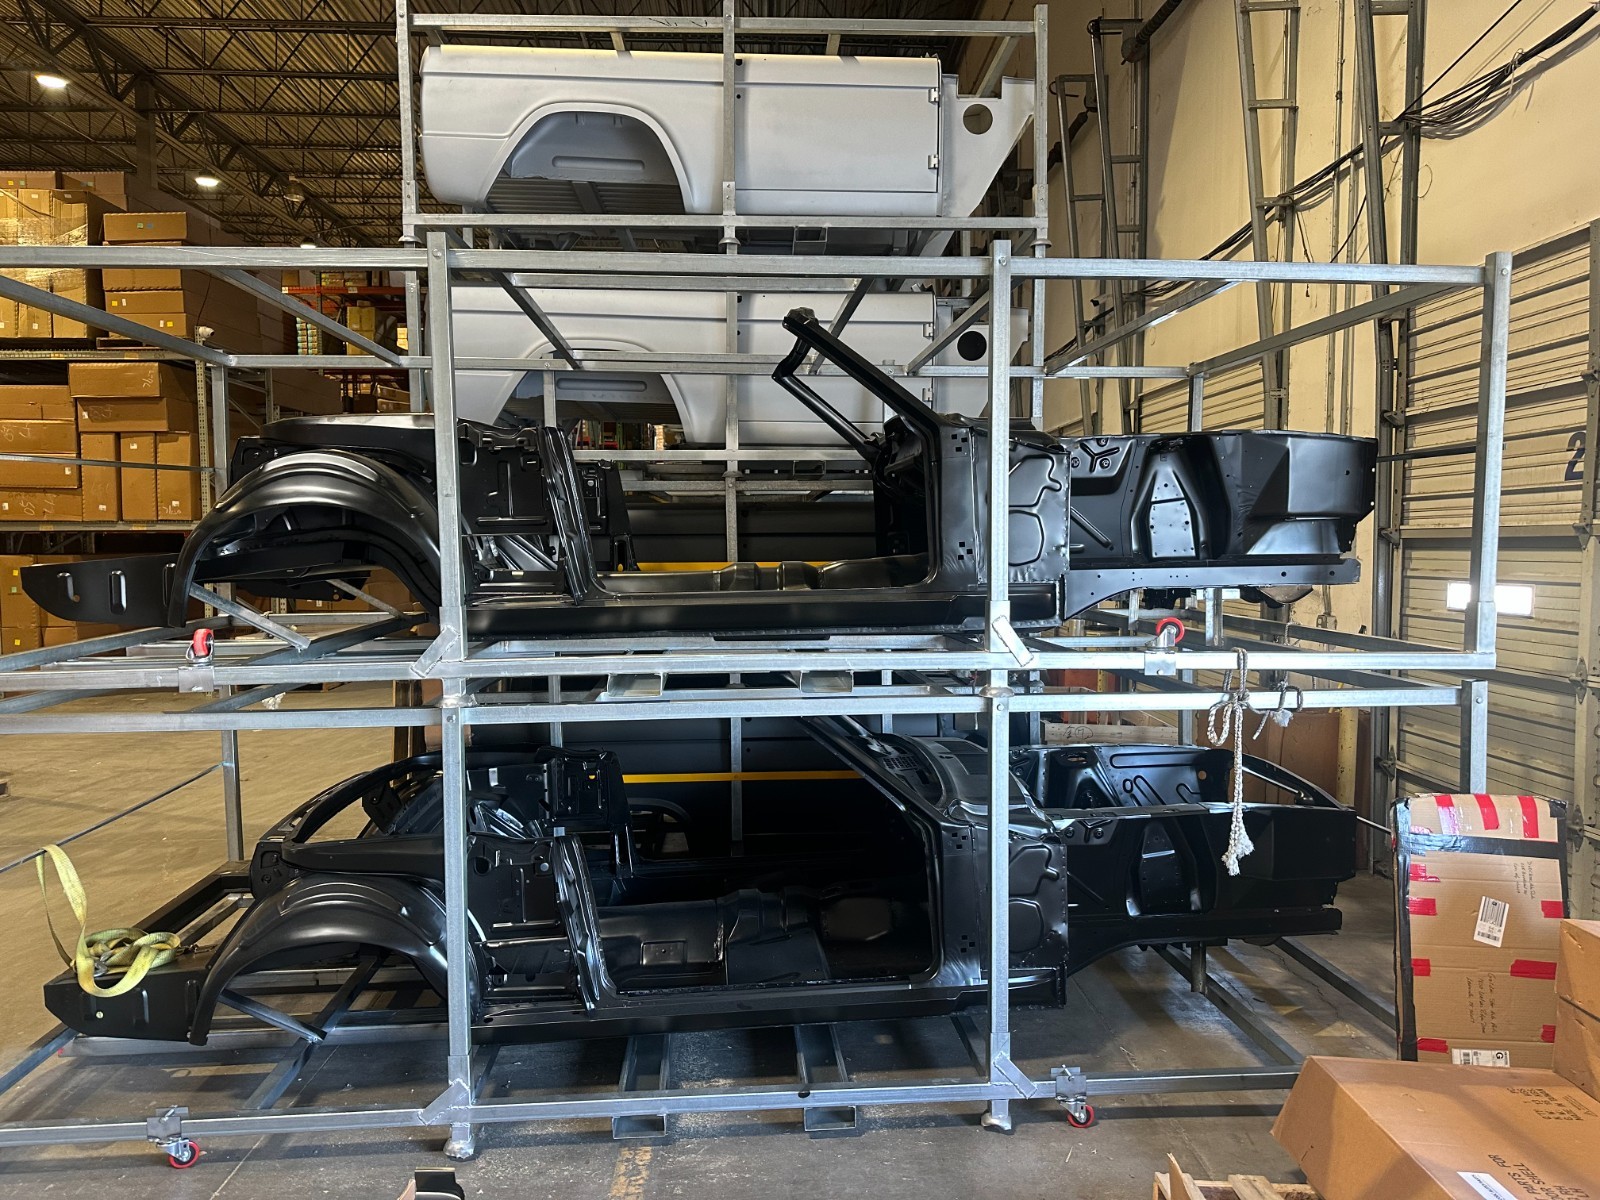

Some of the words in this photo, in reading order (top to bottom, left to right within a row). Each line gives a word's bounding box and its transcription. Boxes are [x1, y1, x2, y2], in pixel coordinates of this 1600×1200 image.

[1564, 431, 1586, 481] 2
[1495, 1052, 1504, 1060] G
[1487, 1154, 1511, 1168] FOR
[1507, 1172, 1540, 1195] PARTS
[1513, 1162, 1546, 1186] SHELL
